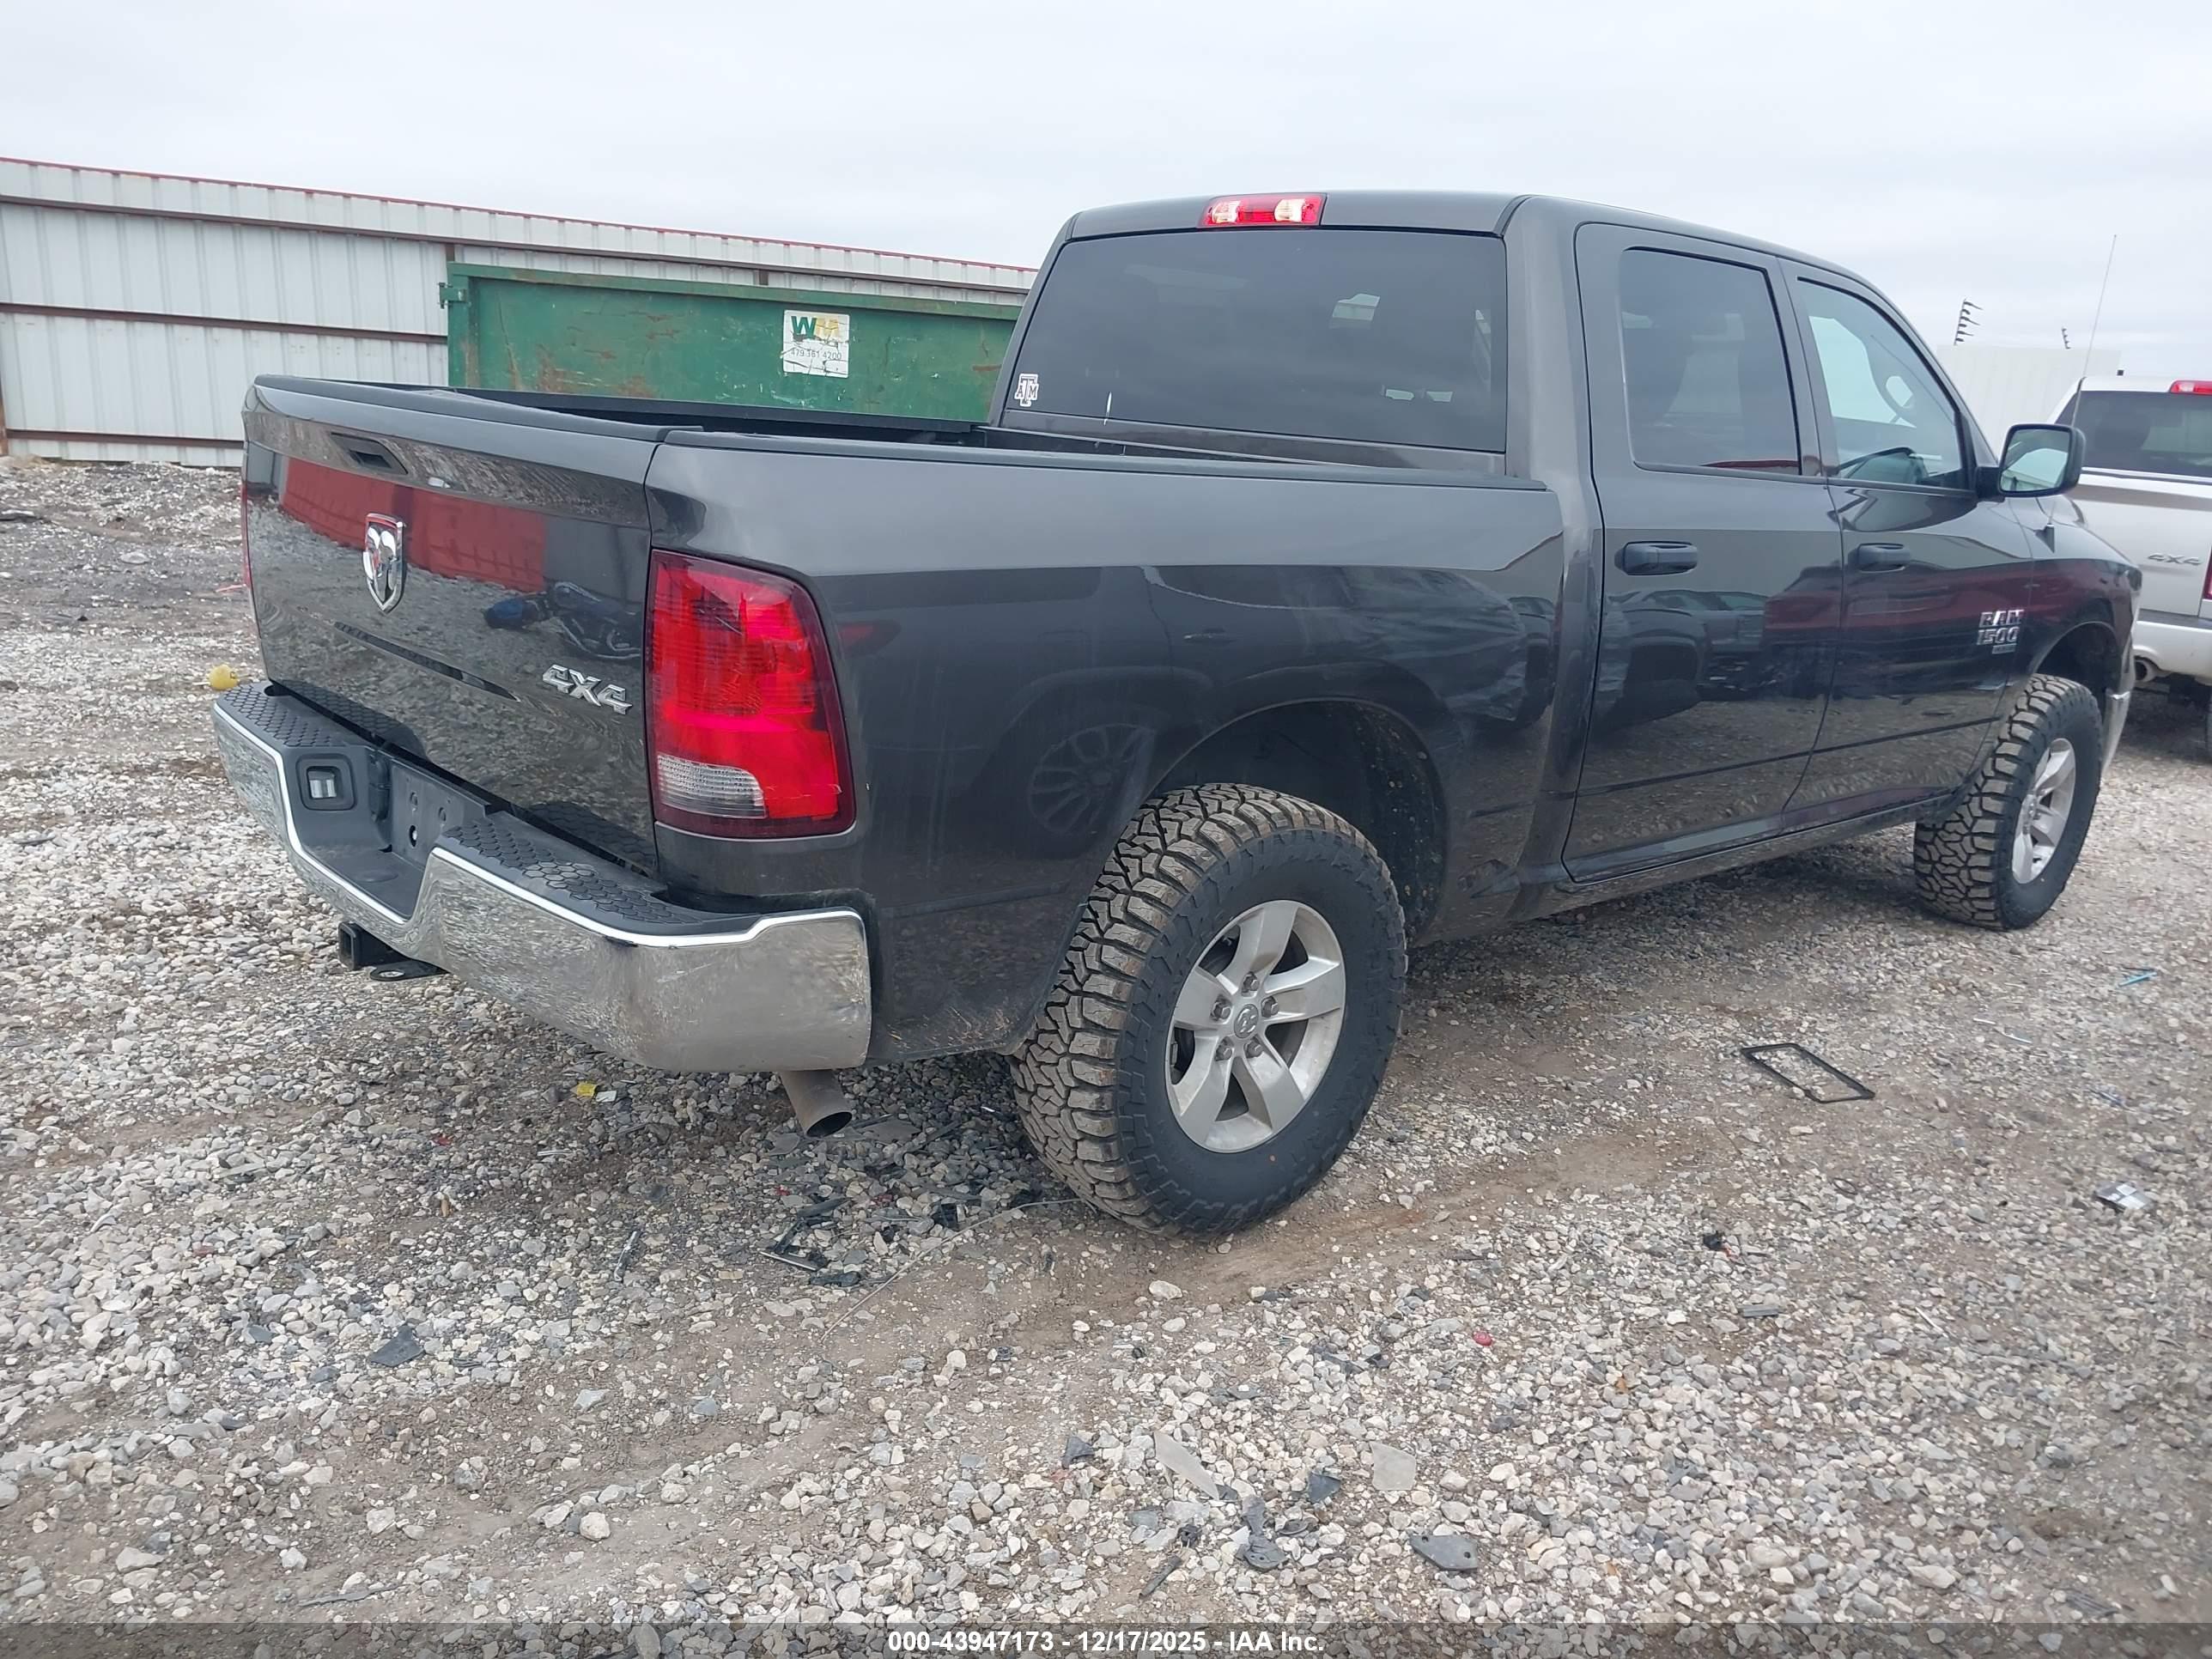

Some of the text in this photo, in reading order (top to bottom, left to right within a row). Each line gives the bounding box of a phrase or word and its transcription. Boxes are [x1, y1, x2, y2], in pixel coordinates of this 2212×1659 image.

[2148, 552, 2203, 566] 4X4
[1976, 627, 2020, 646] 1500
[543, 664, 633, 715] 4X4
